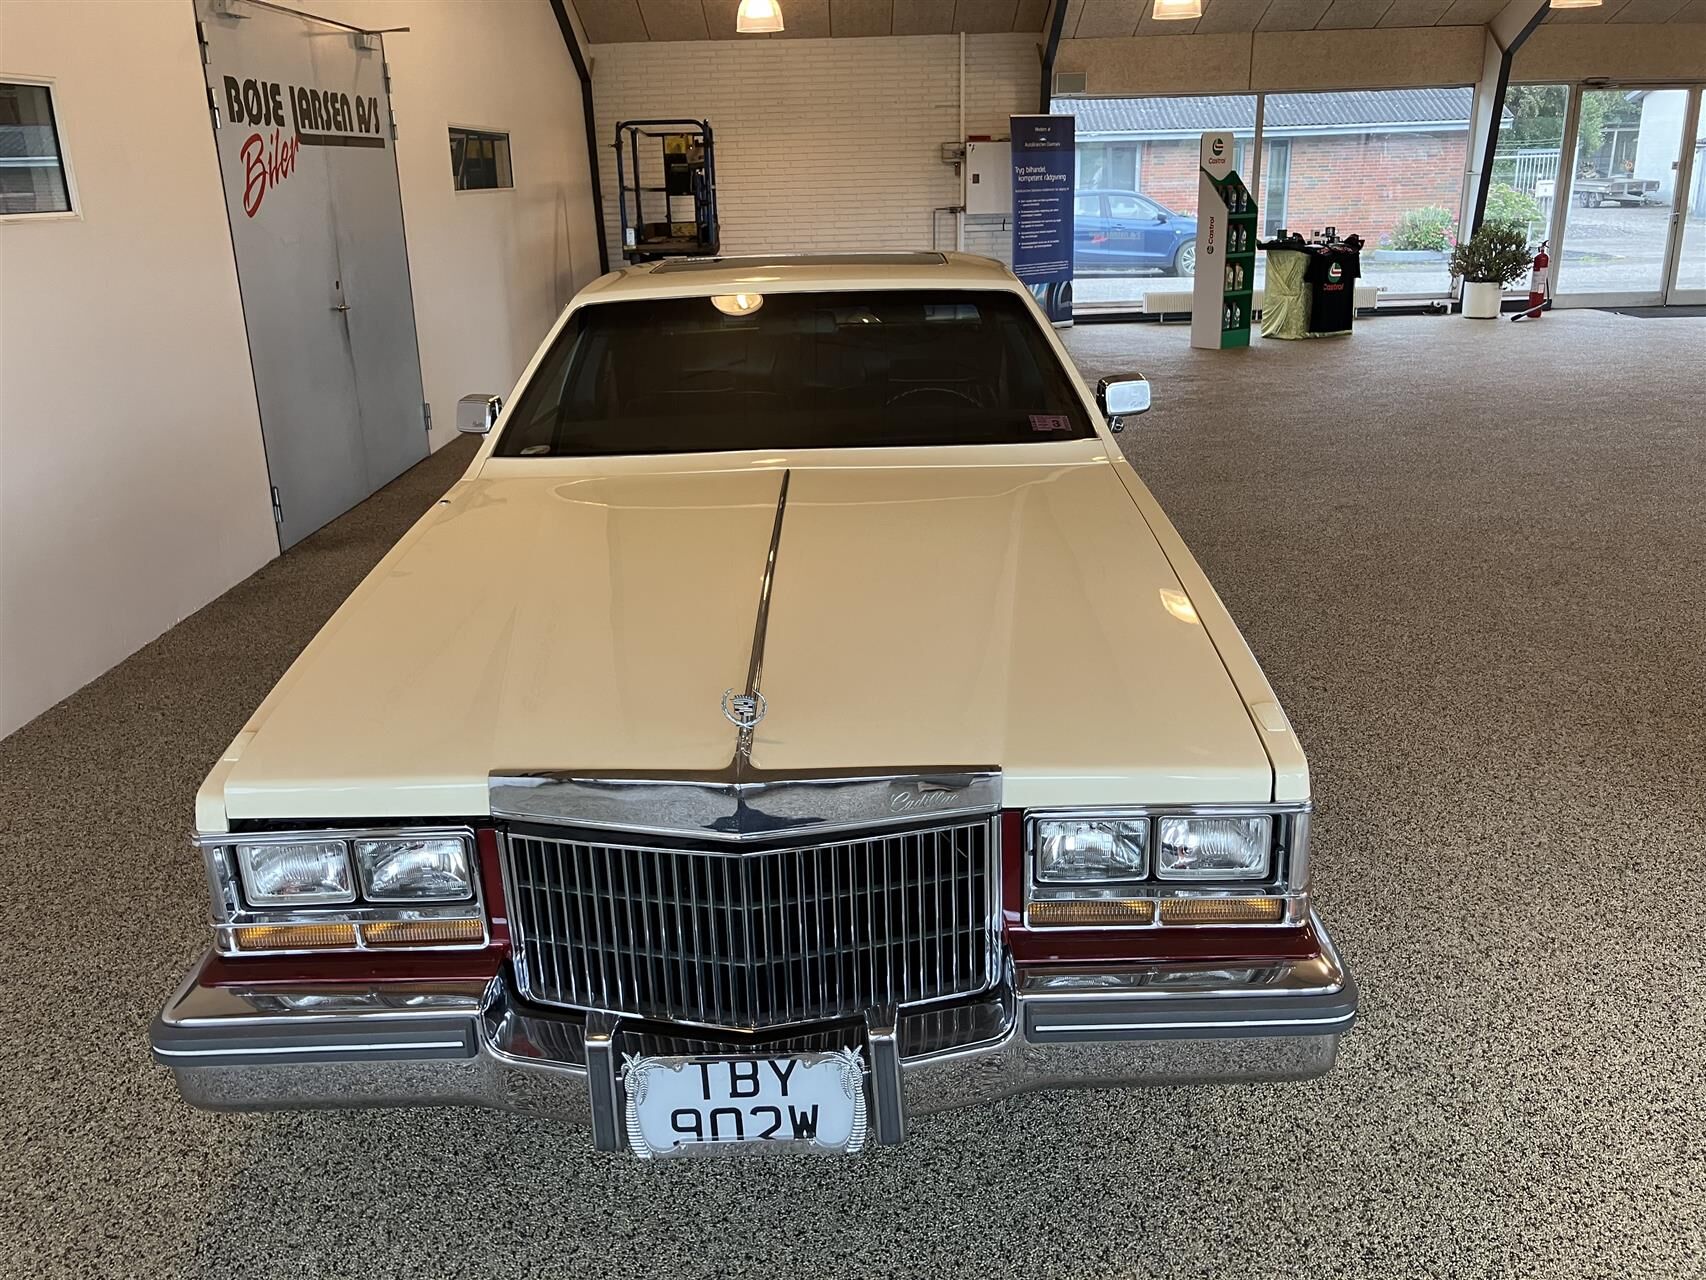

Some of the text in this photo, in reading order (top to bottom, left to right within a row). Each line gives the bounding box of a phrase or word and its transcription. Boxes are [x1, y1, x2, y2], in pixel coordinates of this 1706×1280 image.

[223, 75, 380, 144] BØJE LARSEN A/S
[240, 127, 300, 218] Biler
[890, 791, 961, 812] Cadillac
[688, 1060, 797, 1100] TBY
[671, 1104, 819, 1143] 902W
